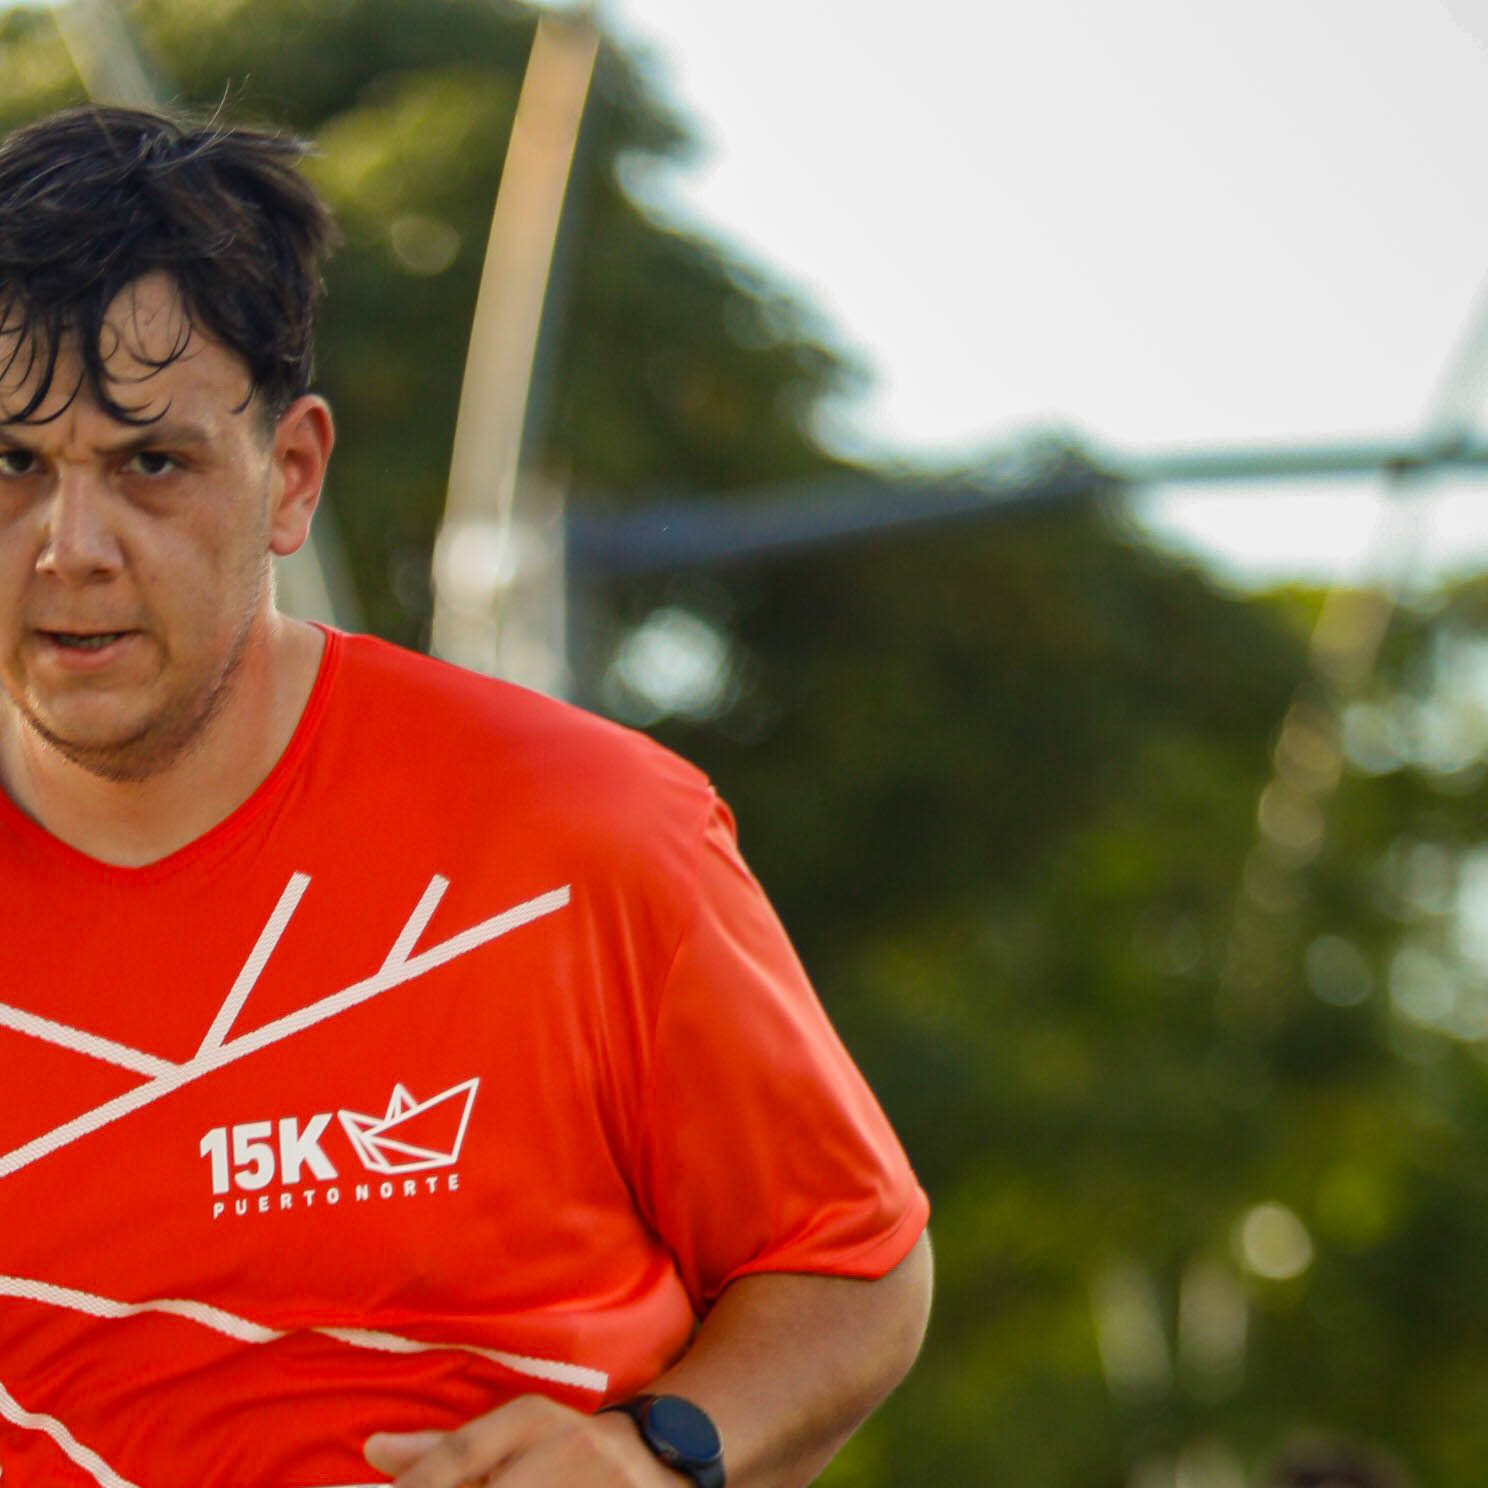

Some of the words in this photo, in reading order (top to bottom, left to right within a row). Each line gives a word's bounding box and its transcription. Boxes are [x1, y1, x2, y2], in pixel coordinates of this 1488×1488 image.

[199, 1112, 341, 1194] 15K
[213, 1187, 342, 1218] PUERTO
[355, 1173, 460, 1200] NORTE
